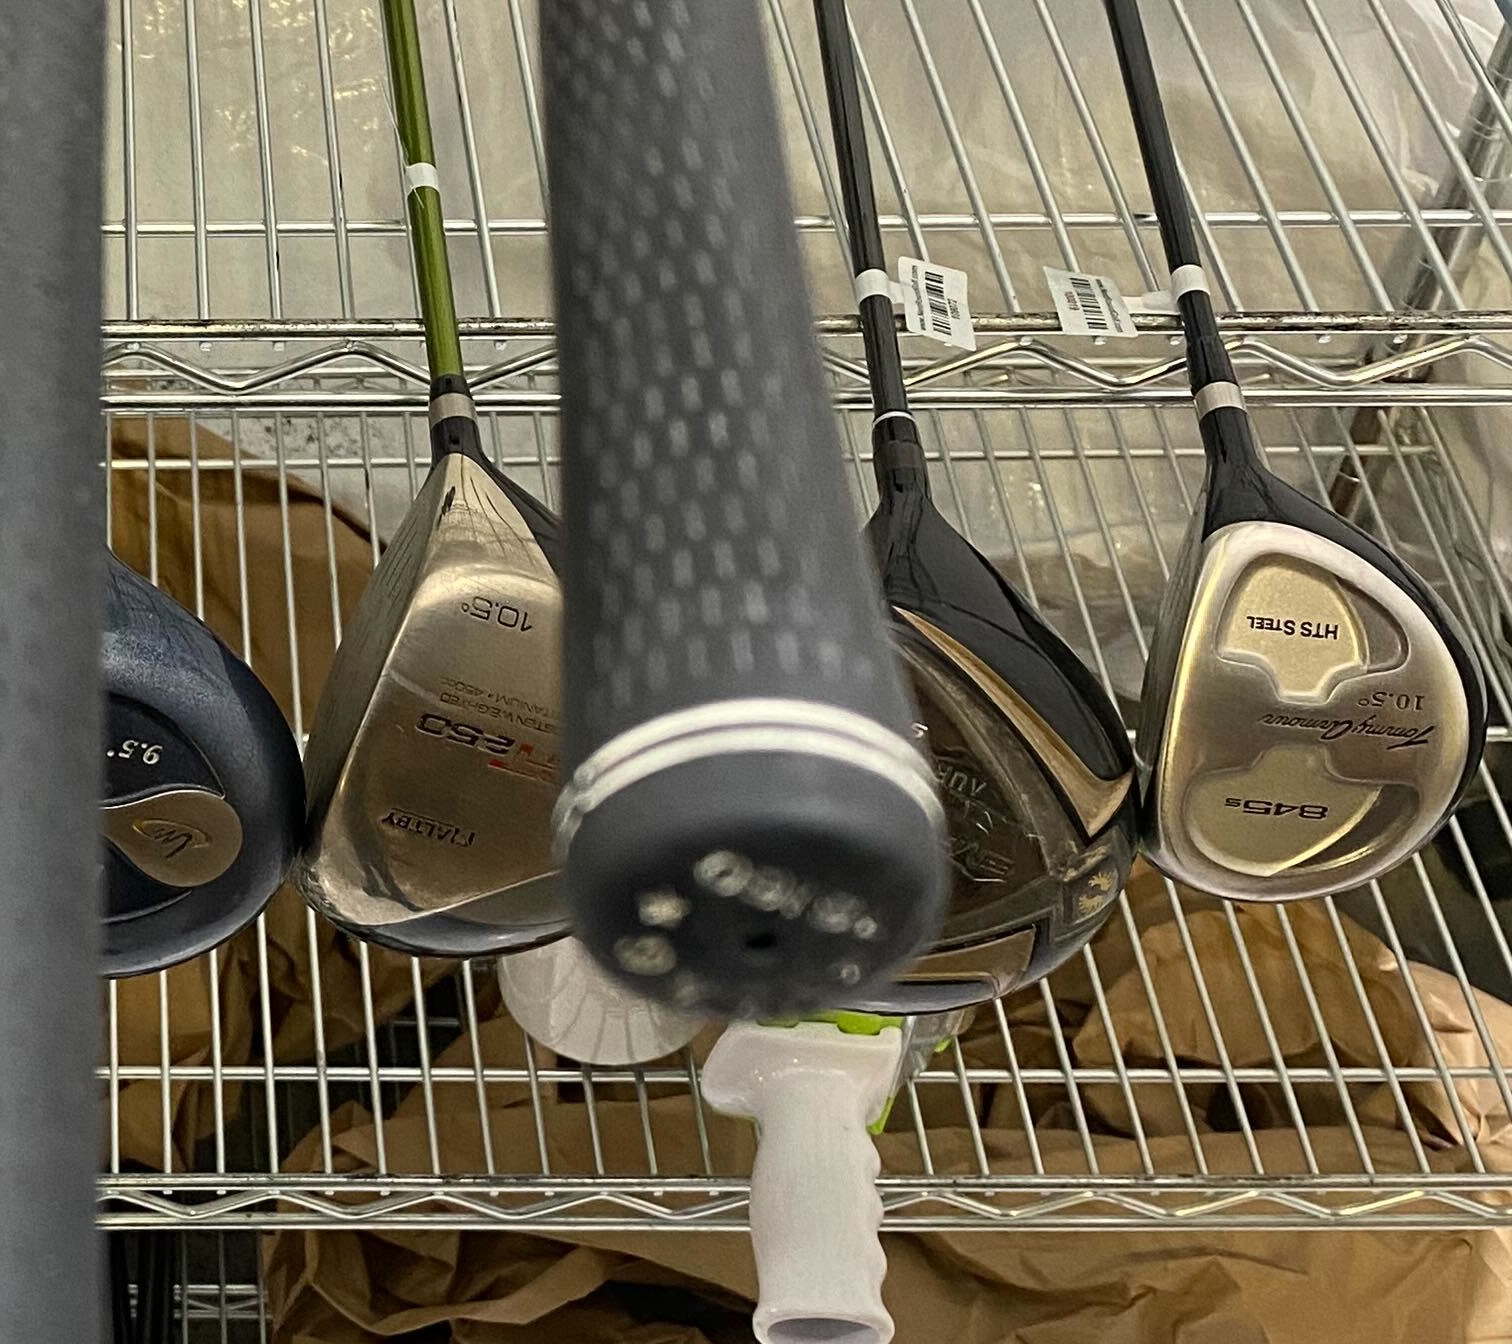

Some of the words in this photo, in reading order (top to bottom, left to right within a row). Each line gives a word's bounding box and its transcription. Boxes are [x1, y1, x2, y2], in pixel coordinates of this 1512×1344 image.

[459, 594, 534, 634] 10.5°
[1299, 620, 1339, 640] HTS
[1356, 690, 1426, 712] 10.5°
[1353, 713, 1435, 751] Tommy
[379, 809, 476, 849] MALTBY
